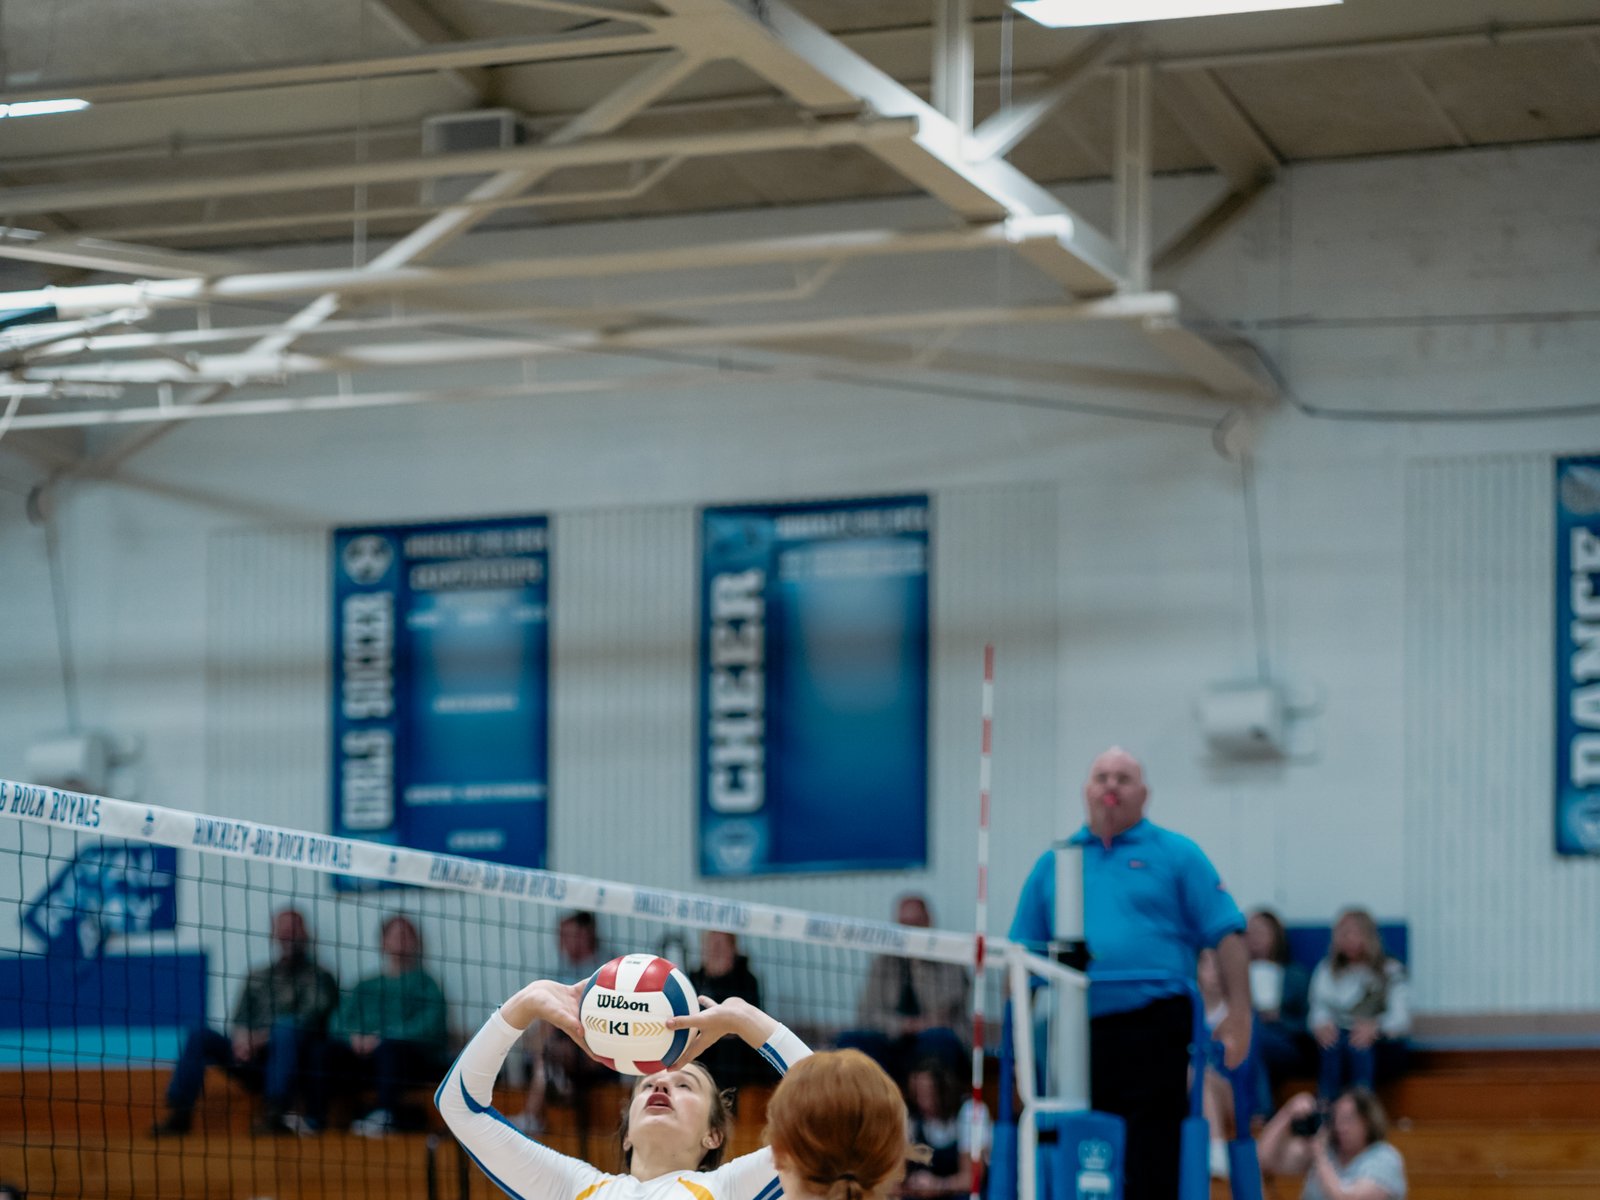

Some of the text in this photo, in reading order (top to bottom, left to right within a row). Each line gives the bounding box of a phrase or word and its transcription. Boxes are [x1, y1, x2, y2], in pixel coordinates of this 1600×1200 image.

[708, 567, 765, 812] CHEER
[10, 785, 46, 817] ROCK
[50, 791, 100, 828] ROYALS
[597, 994, 649, 1013] Wilson
[609, 1021, 629, 1036] K1
